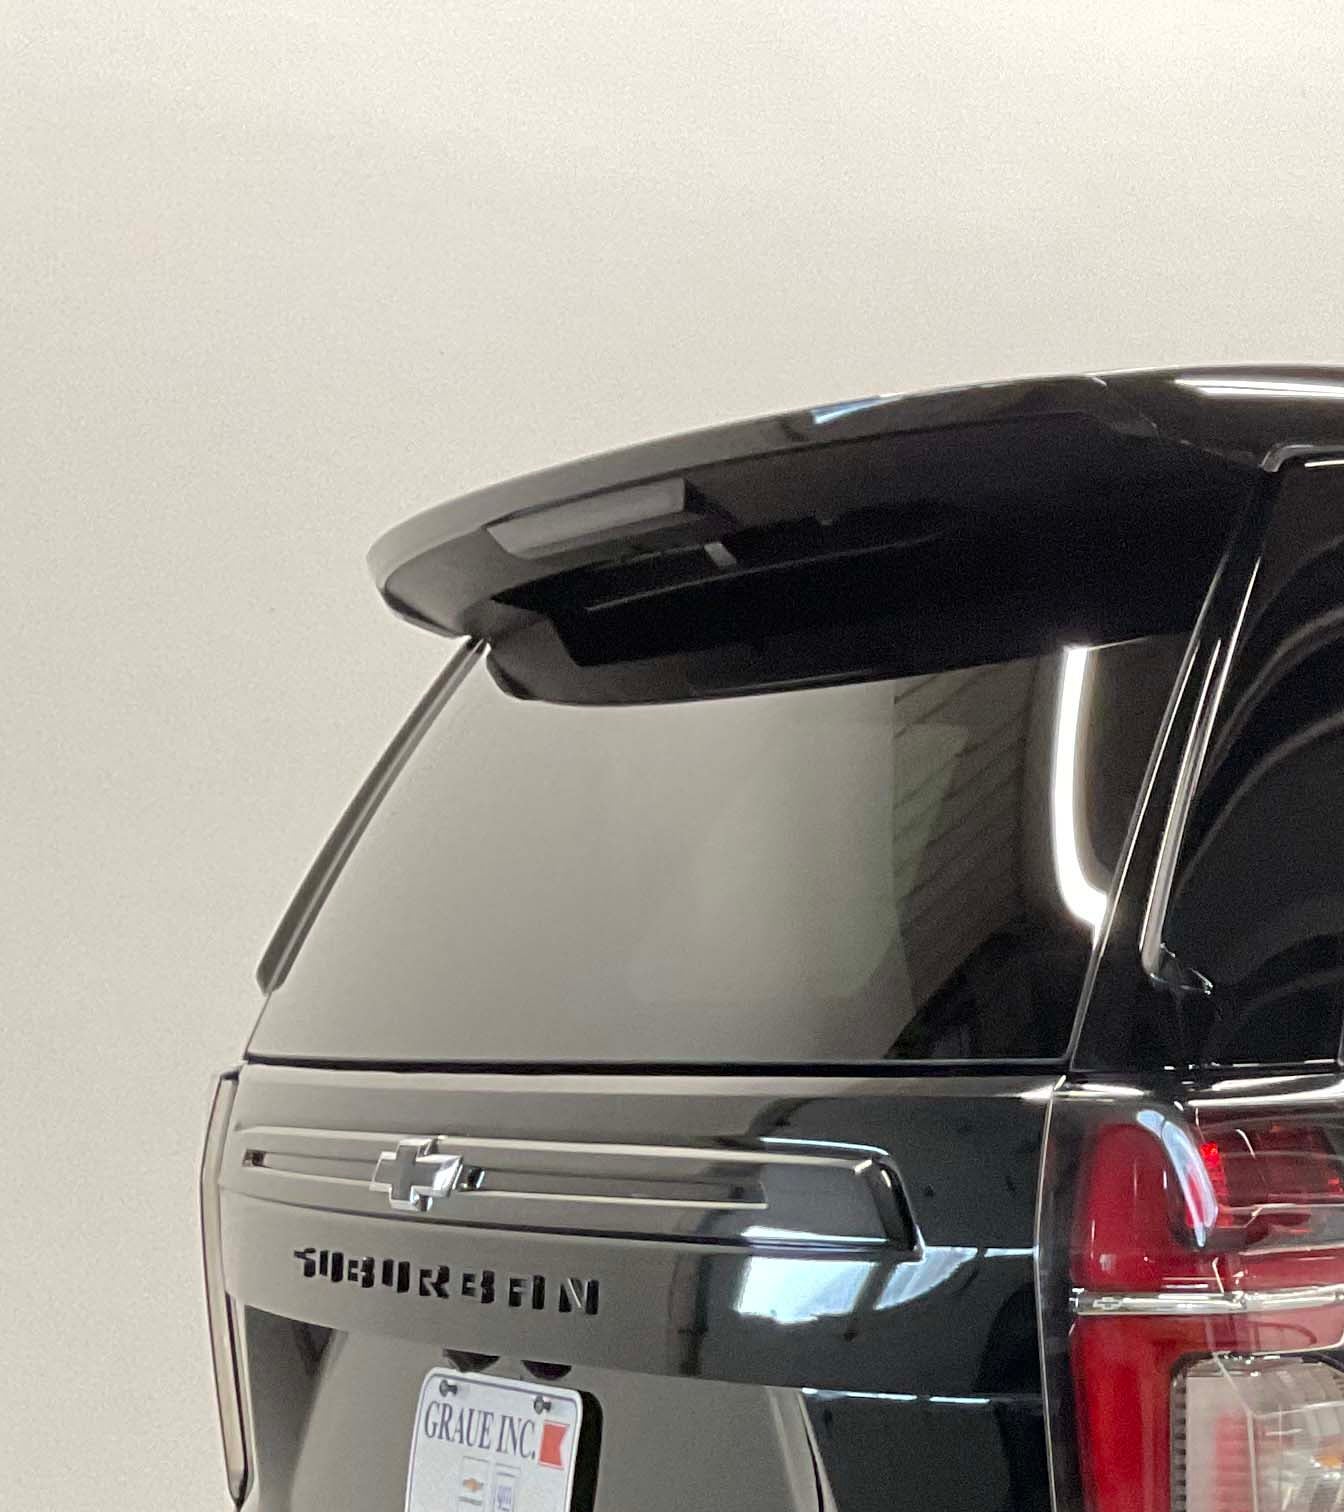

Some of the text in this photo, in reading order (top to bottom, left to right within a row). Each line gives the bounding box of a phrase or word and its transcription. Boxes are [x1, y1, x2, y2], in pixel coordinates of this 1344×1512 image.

[294, 1247, 600, 1316] SUBURBAN
[424, 1400, 536, 1460] GRAUE INC.
